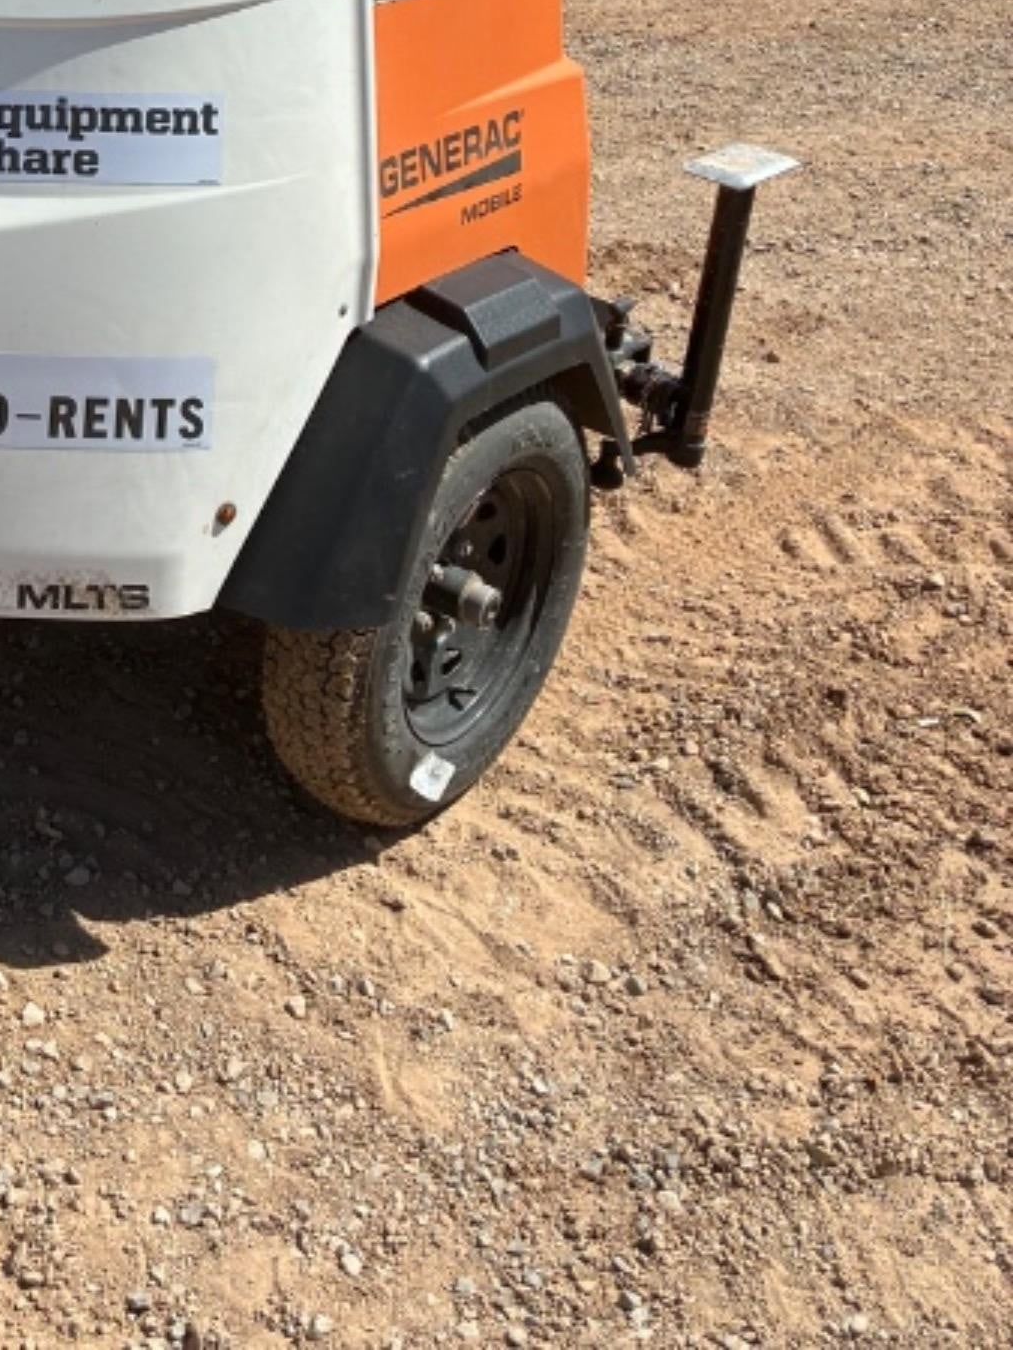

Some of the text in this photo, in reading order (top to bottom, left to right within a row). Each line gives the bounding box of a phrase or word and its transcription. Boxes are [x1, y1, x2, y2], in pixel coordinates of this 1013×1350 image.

[380, 110, 523, 199] GENERAC
[461, 183, 524, 226] MOBILE
[16, 584, 149, 611] MLTS
